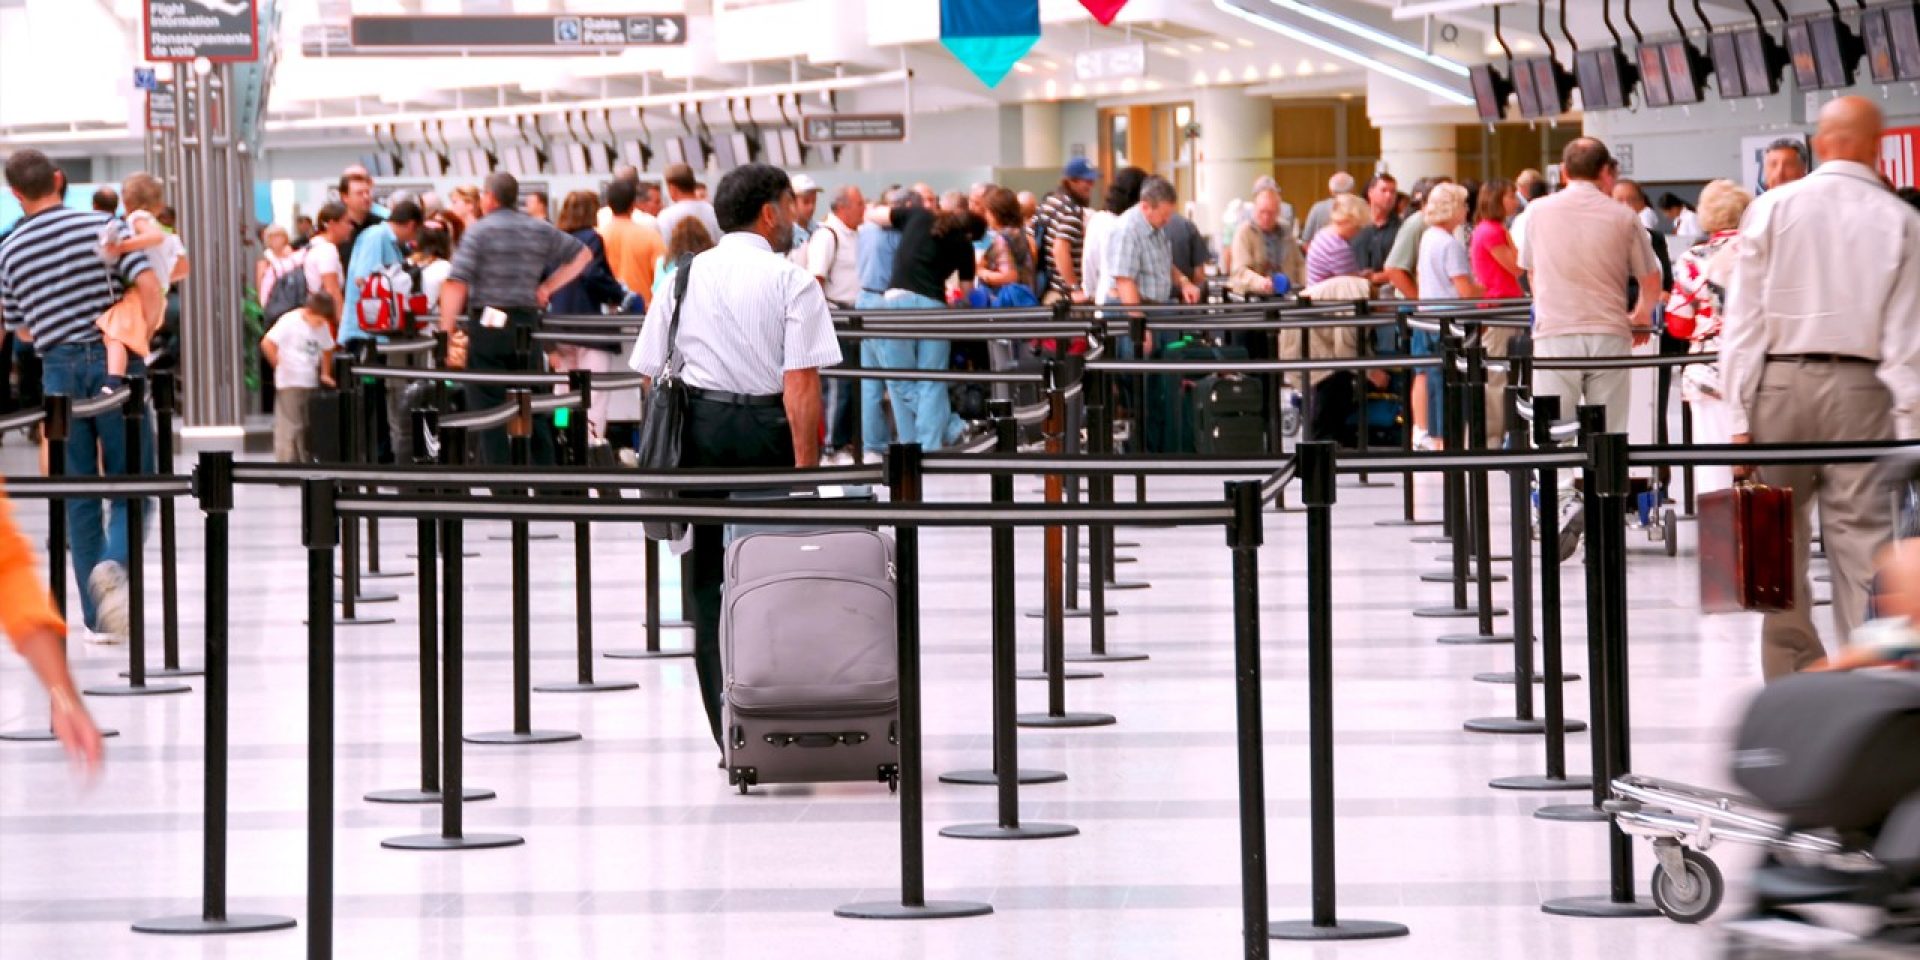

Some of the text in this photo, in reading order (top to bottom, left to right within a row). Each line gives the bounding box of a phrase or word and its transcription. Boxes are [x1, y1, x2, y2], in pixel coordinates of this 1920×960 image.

[151, 2, 186, 17] Flight
[151, 16, 220, 28] Information
[583, 17, 621, 30] Gates
[152, 32, 251, 48] Renseignements
[152, 45, 196, 57] de vols
